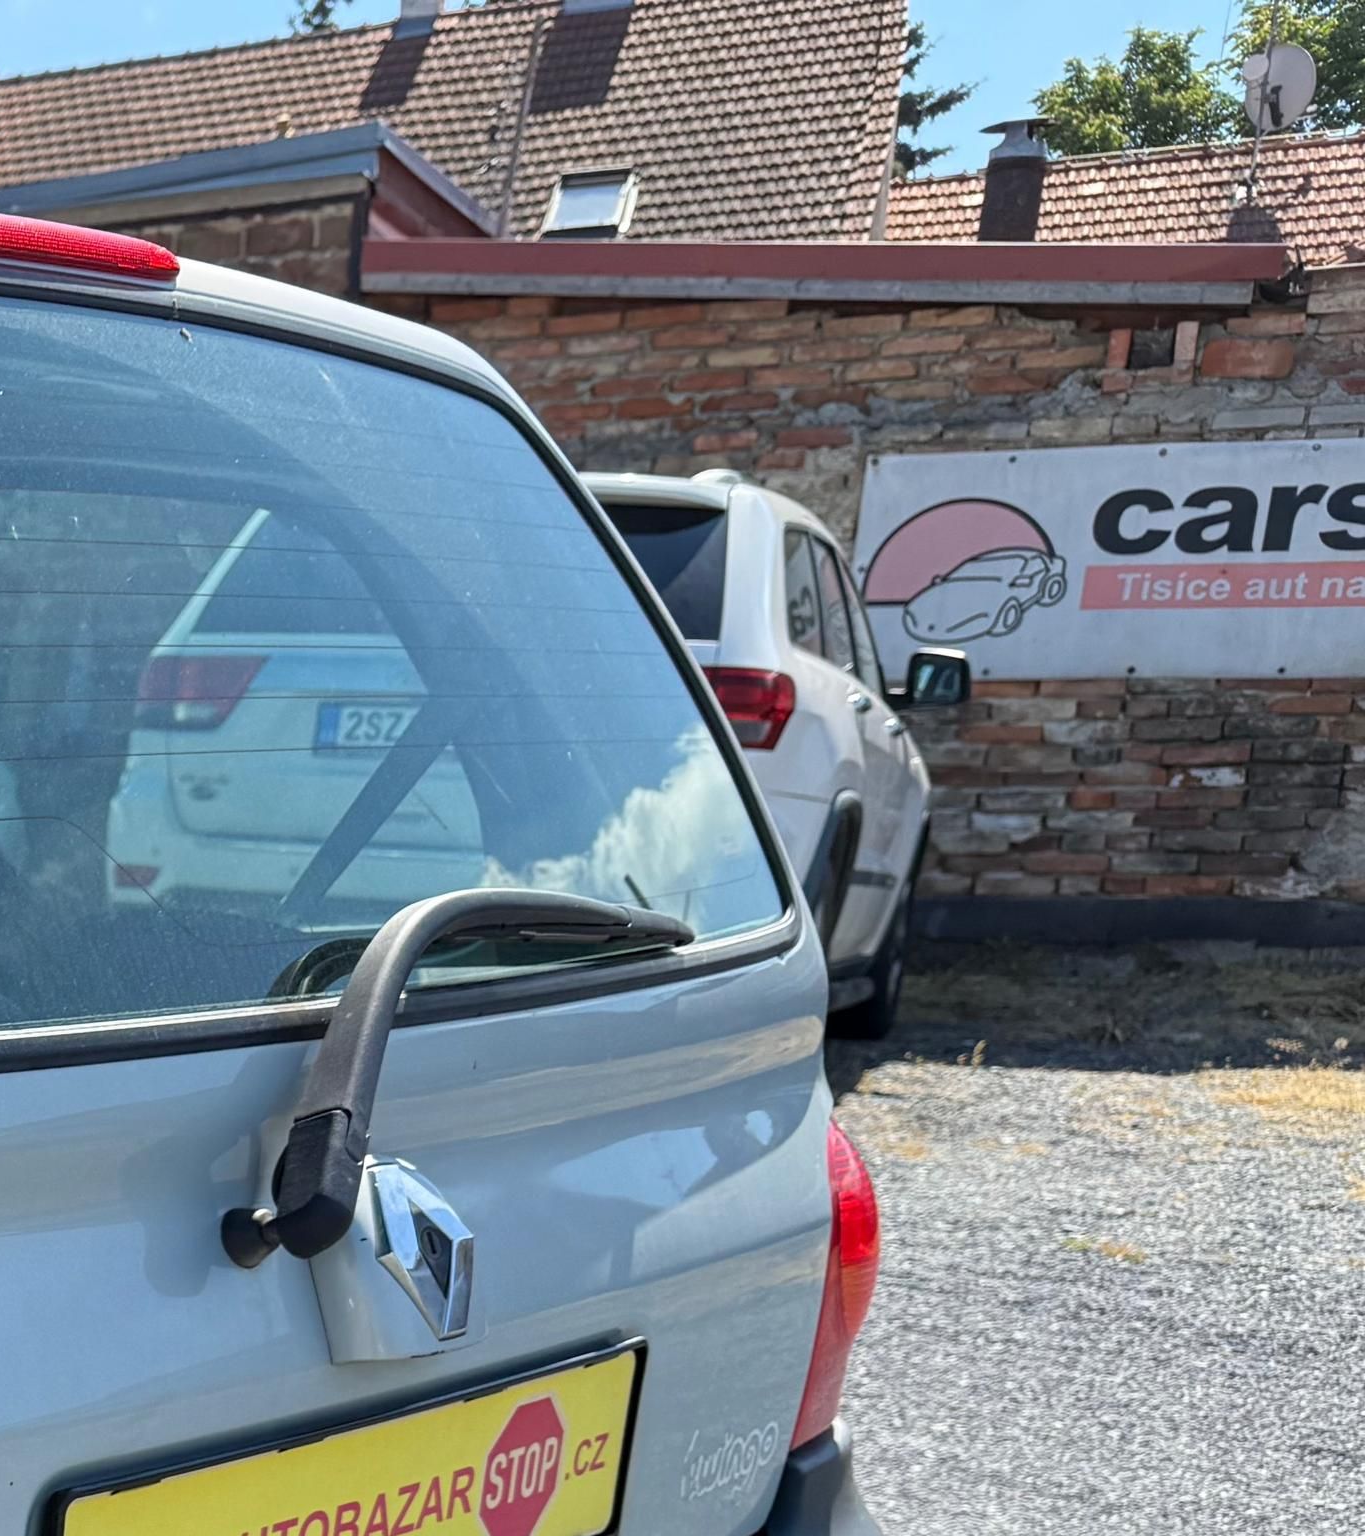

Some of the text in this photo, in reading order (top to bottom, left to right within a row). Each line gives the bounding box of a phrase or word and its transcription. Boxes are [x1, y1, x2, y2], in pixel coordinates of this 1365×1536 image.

[1117, 571, 1365, 601] Tisíce aut na
[344, 711, 403, 742] 2SZ
